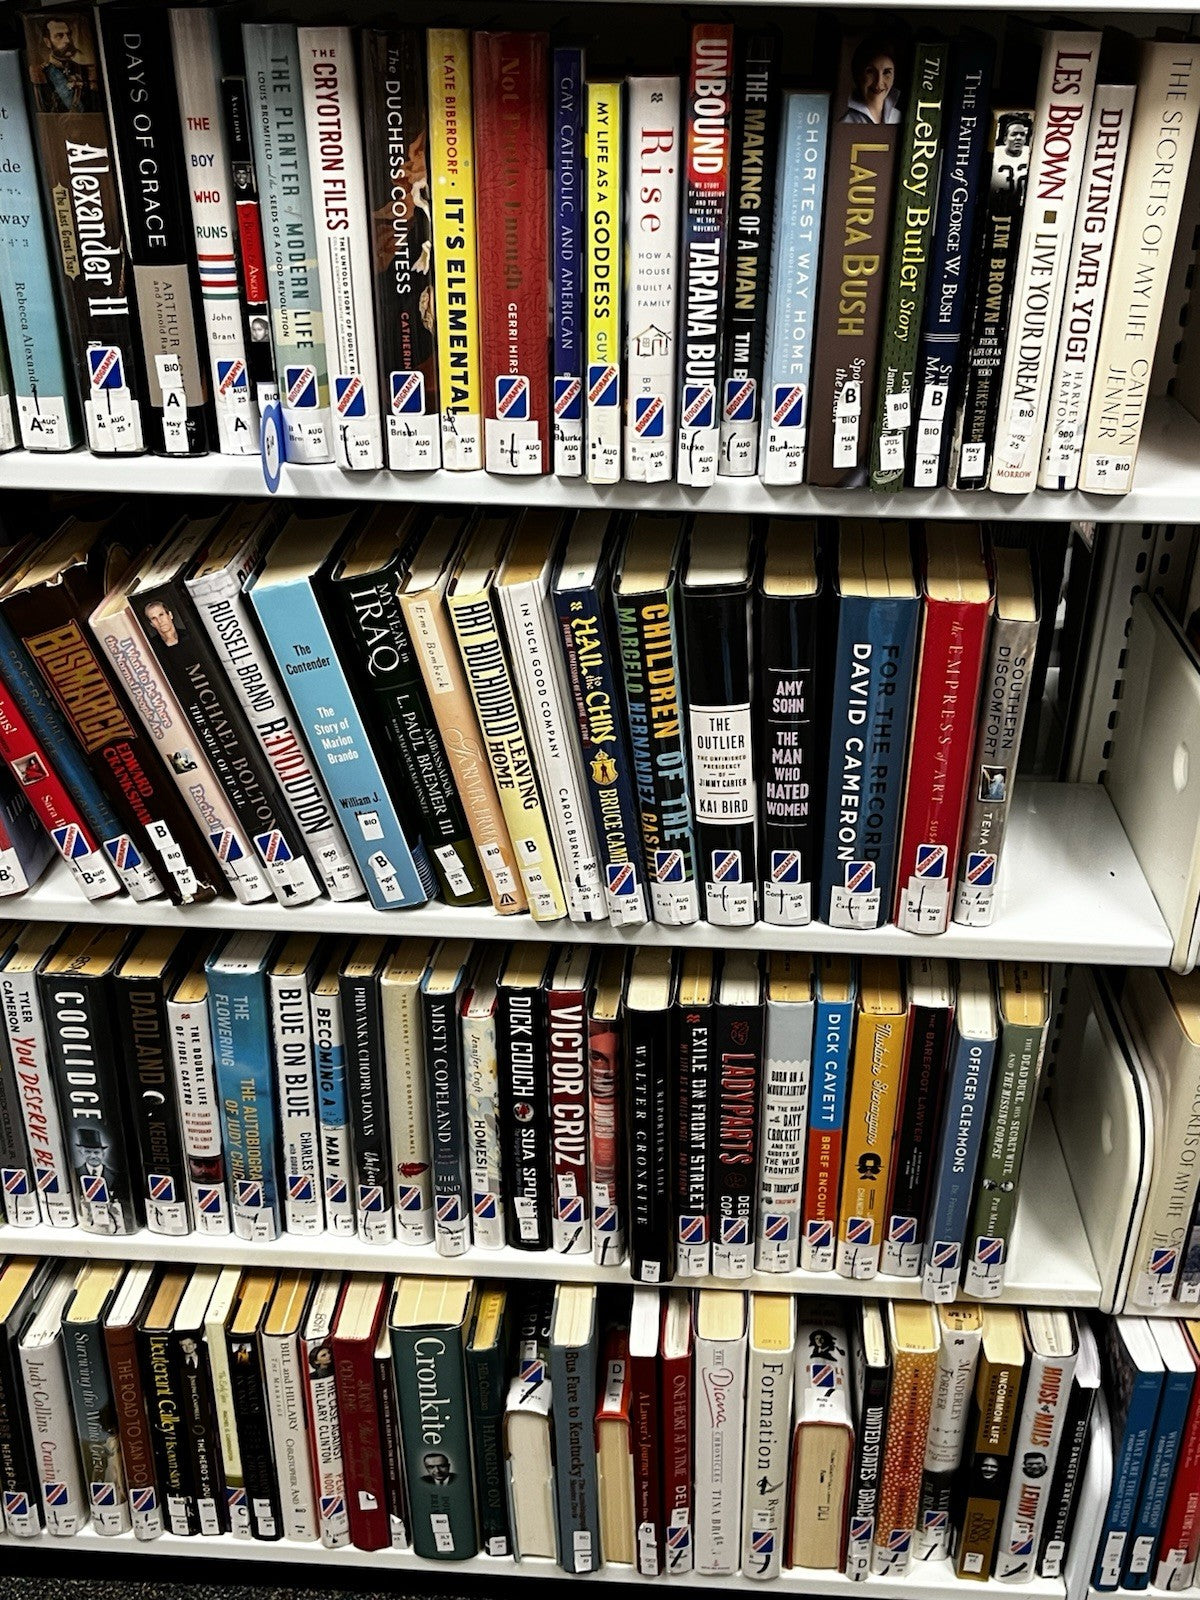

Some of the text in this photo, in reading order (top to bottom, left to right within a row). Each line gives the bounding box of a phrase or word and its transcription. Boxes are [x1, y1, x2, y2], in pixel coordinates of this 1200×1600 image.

[123, 33, 166, 247] DAYS OF GRACE
[187, 118, 210, 130] THE
[313, 63, 345, 171] CRYOTRON
[385, 81, 405, 179] DUCHESS
[443, 55, 458, 175] KATE BIBERDORF
[693, 38, 728, 174] UNBOUND
[1036, 51, 1093, 201] LES BROWN
[191, 155, 215, 167] BOY
[194, 191, 220, 203] WHO
[640, 127, 673, 232] Rise
[893, 58, 941, 343] The LeRoy Butler Story
[1125, 58, 1193, 341] THE SECRETS OF MY LIFE
[59, 209, 68, 227] Last
[62, 230, 72, 252] Great
[65, 140, 129, 317] Alexander II
[197, 226, 228, 238] RUNS
[323, 179, 349, 231] FILES
[390, 187, 411, 294] COUNTESS
[560, 78, 575, 349] GAY, CATHOLIC, AND AMERICAN
[790, 112, 820, 374] SHORTEST WAY HOME
[837, 144, 889, 336] LAURA BUSH
[1066, 108, 1124, 363] DRIVING MR. YOGI
[212, 313, 233, 322] John
[445, 199, 470, 415] IT'S ELEMENTAL
[687, 238, 720, 337] TARANA
[1021, 233, 1057, 341] LIVE YOUR
[212, 333, 236, 341] Brant
[499, 379, 525, 413] BIOGRAPHY
[1098, 365, 1126, 439] JENNER
[1119, 359, 1148, 445] CAITLYN
[208, 600, 275, 712] RUSSELL BRAND
[286, 657, 330, 675] Contender
[293, 645, 311, 656] The
[351, 586, 399, 677] IRAQ
[454, 601, 520, 737] ART BUCHWALD
[618, 607, 644, 694] MARCELO
[26, 622, 136, 751] BISMARCK
[317, 706, 335, 718] The
[520, 604, 560, 758] IN SUCH GOOD COMPANY
[641, 603, 690, 841] CHILDREN OF THE
[773, 698, 804, 713] SOHN
[776, 681, 803, 696] AMY
[984, 647, 1011, 758] DISCOMFORT
[1001, 657, 1026, 749] SOUTHERN
[185, 662, 276, 830] MICHAEL BOLTON
[314, 719, 349, 736] Story of
[321, 736, 353, 750] Marlon
[328, 751, 359, 765] Brando
[489, 741, 514, 790] HOME
[697, 735, 745, 749] OUTLIER
[709, 718, 731, 731] THE
[772, 749, 802, 764] MAN
[777, 732, 798, 746] THE
[837, 644, 872, 861] DAVID CAMERON
[865, 645, 899, 860] FOR THE RECORD
[116, 743, 153, 797] EDWARD
[508, 736, 540, 810] LEAVING
[598, 788, 622, 830] BRUCE
[700, 799, 748, 813] KAI BIRD
[767, 783, 809, 799] HATED
[767, 802, 808, 816] WOMEN
[775, 768, 800, 781] WHO
[154, 826, 167, 838] B
[979, 812, 993, 846] TENA
[3, 981, 20, 1033] CAMERON
[18, 991, 33, 1023] TYLER
[129, 991, 165, 1086] DADLAND
[214, 993, 235, 1067] FLOWERING
[234, 996, 249, 1020] THE
[509, 997, 534, 1097] DICK COUCH
[54, 991, 102, 1119] COOLIDGE
[175, 1025, 192, 1106] OF FIDEL CASTRO
[190, 1026, 208, 1106] THE DOUBLE LIFE
[279, 988, 309, 1118] BLUE ON BLUE
[430, 1004, 451, 1143] MISTY COPELAND
[551, 1005, 585, 1167] VICTOR CRUZ
[822, 1014, 841, 1122] DICK CAVETT
[635, 1045, 648, 1225] WALTER CRONKITE
[720, 1053, 755, 1164] LADYPARTS
[952, 1046, 982, 1174] OFFICER CLEMMONS
[325, 1136, 341, 1167] MAN
[819, 1136, 831, 1168] BRIEF
[26, 1359, 52, 1433] Judy Collins
[117, 1358, 144, 1461] THE ROAD TO SAN
[314, 1382, 332, 1464] HILLARY CLINTON
[414, 1337, 450, 1445] Cronkite
[758, 1362, 784, 1469] Formation
[989, 1371, 1009, 1444] UNCOMMON LIFE
[860, 1406, 883, 1481] UNITED STATES
